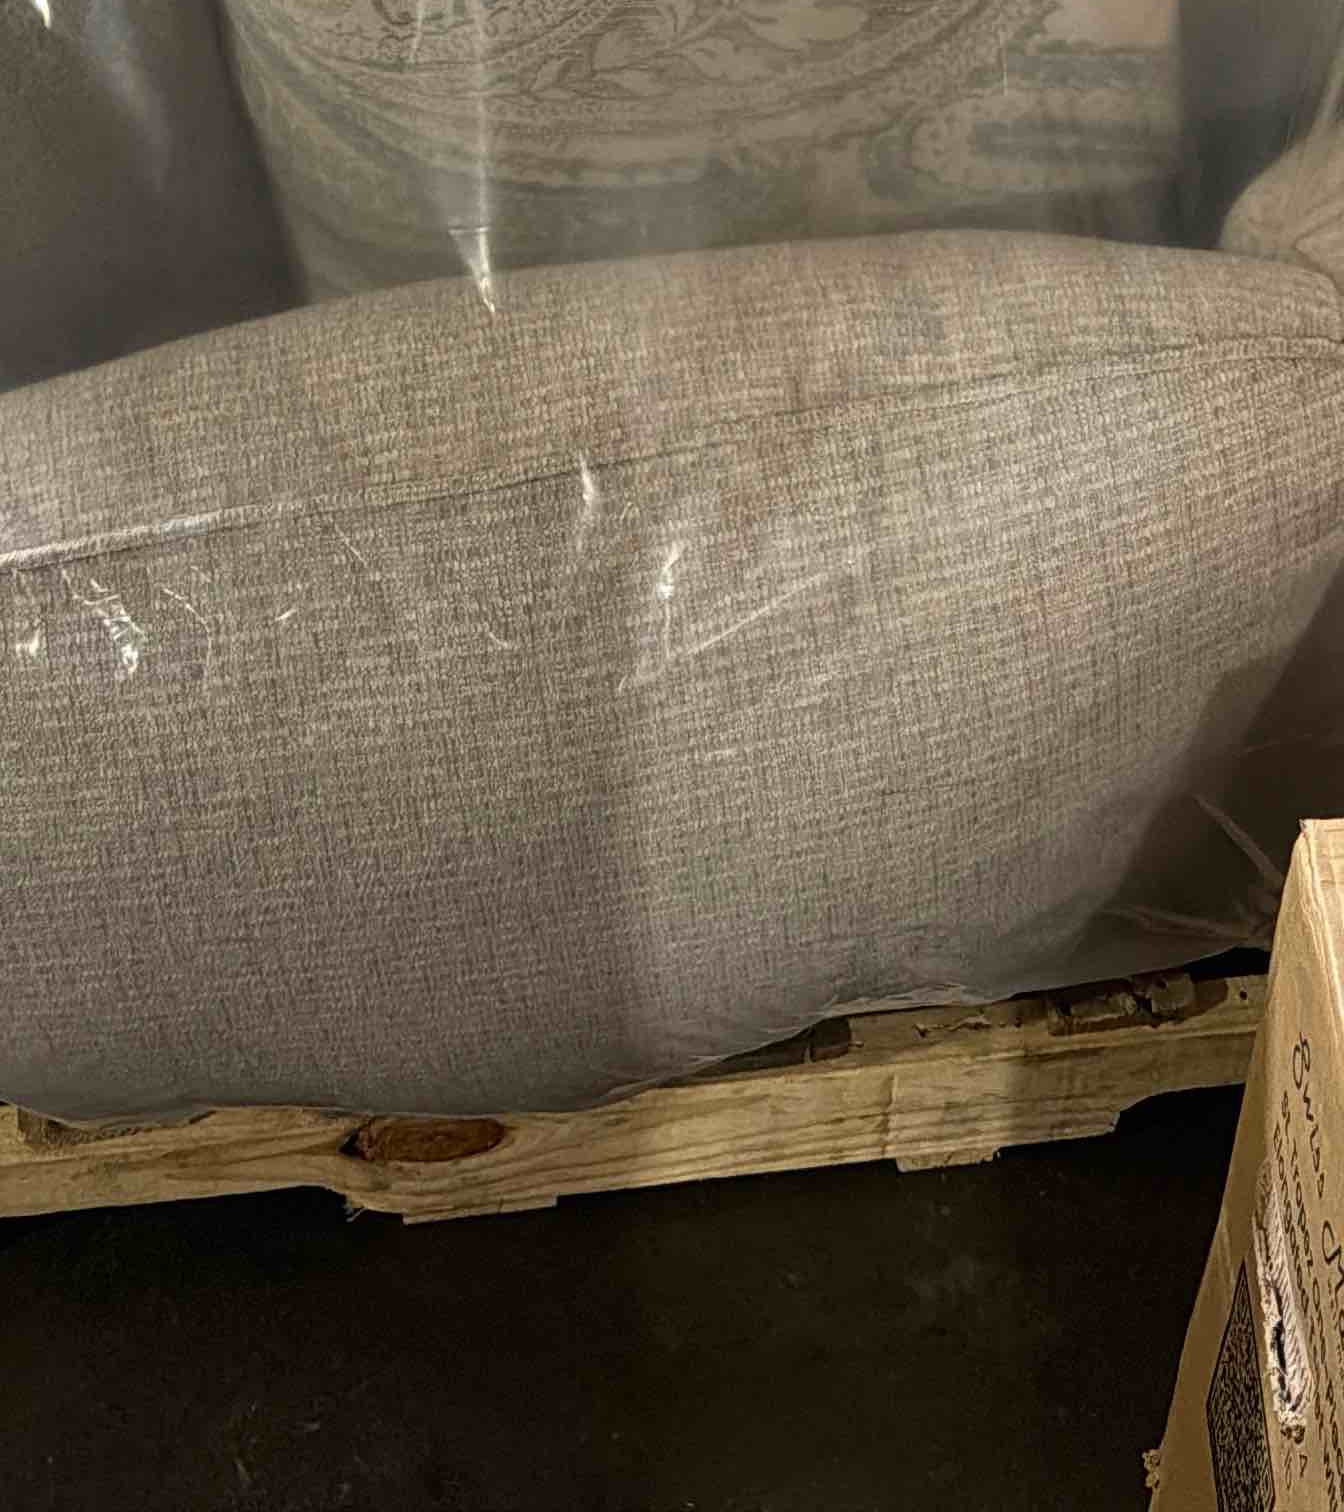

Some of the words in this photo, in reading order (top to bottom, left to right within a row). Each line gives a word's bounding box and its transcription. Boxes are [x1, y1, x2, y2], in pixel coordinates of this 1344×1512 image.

[1292, 1031, 1324, 1199] Swiss
[1273, 1119, 1309, 1319] Elongated
[1291, 1137, 1314, 1279] Tropez
